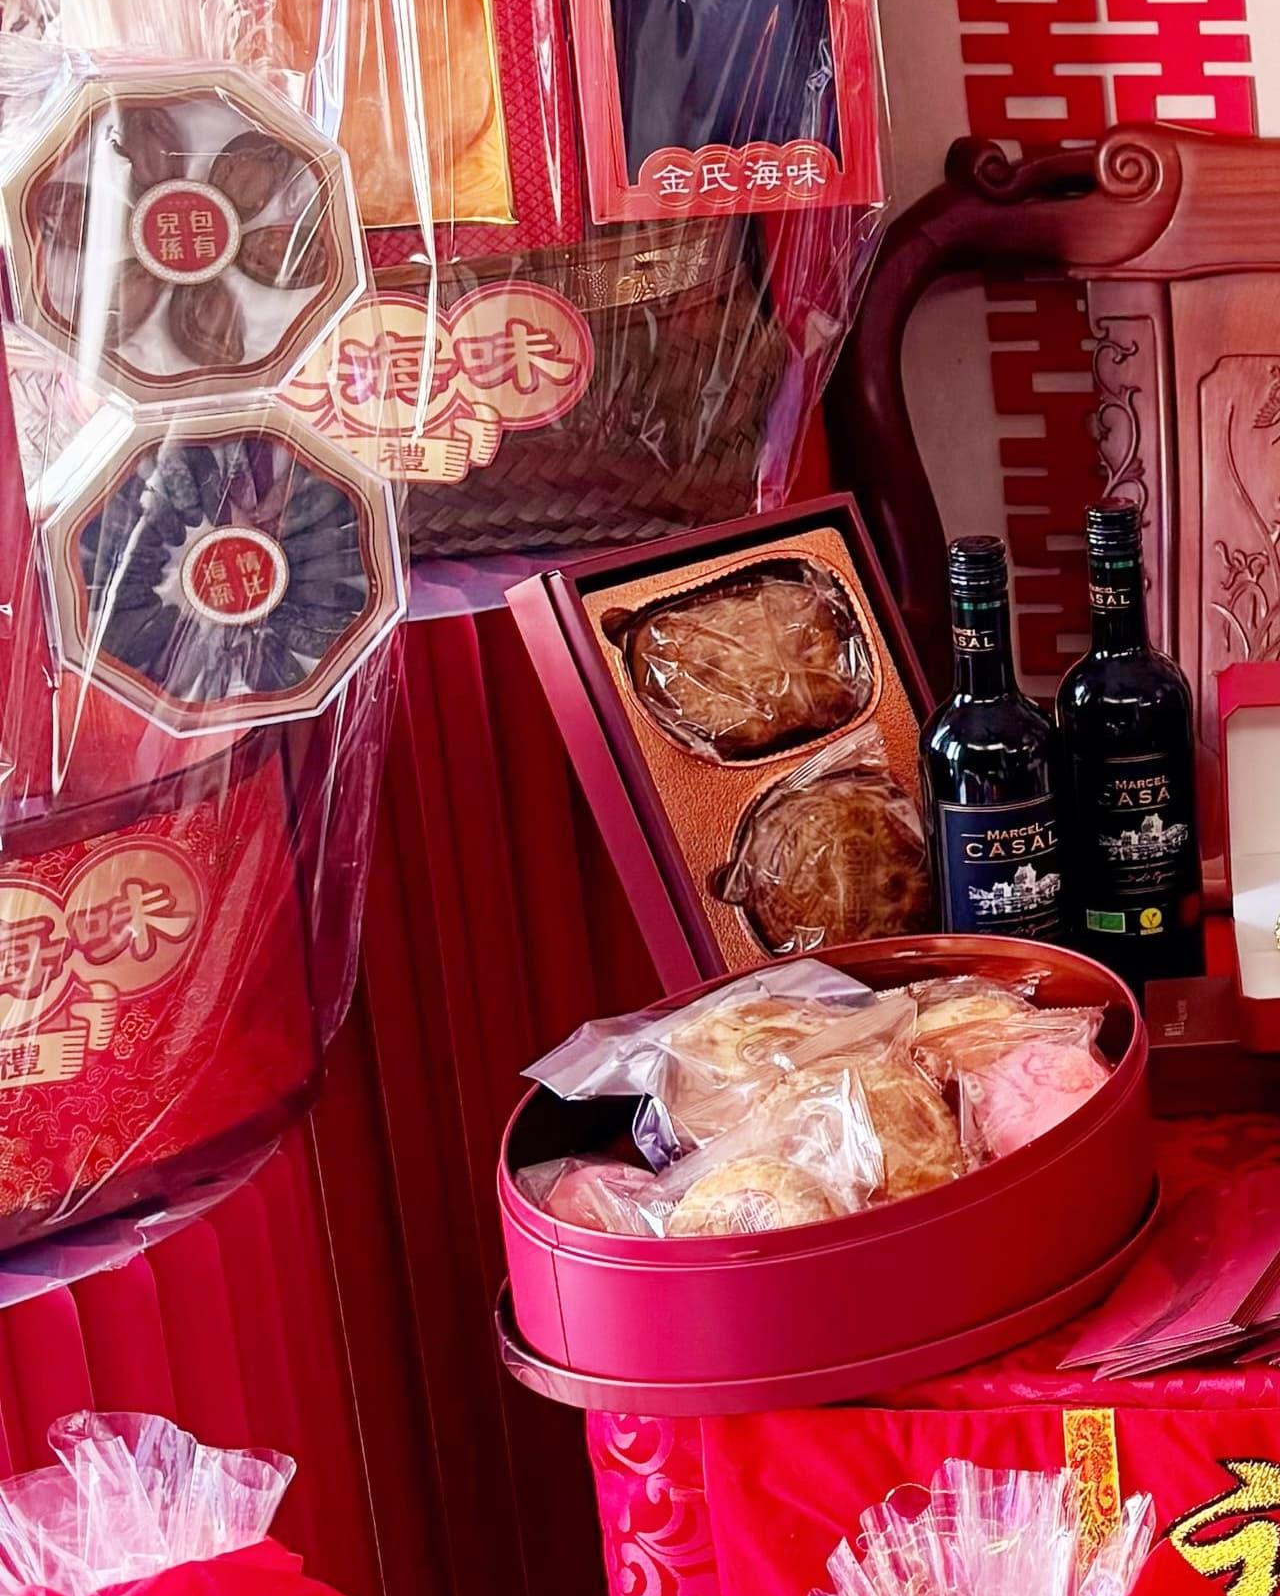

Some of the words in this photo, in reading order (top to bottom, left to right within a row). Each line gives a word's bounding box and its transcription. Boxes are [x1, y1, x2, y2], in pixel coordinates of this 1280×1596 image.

[652, 162, 827, 197] 金氏海味
[325, 317, 575, 397] 海味
[1115, 775, 1169, 790] MARCEL
[1100, 787, 1172, 806] ASA
[987, 822, 1044, 841] MARCEL
[966, 830, 1059, 858] CASAL
